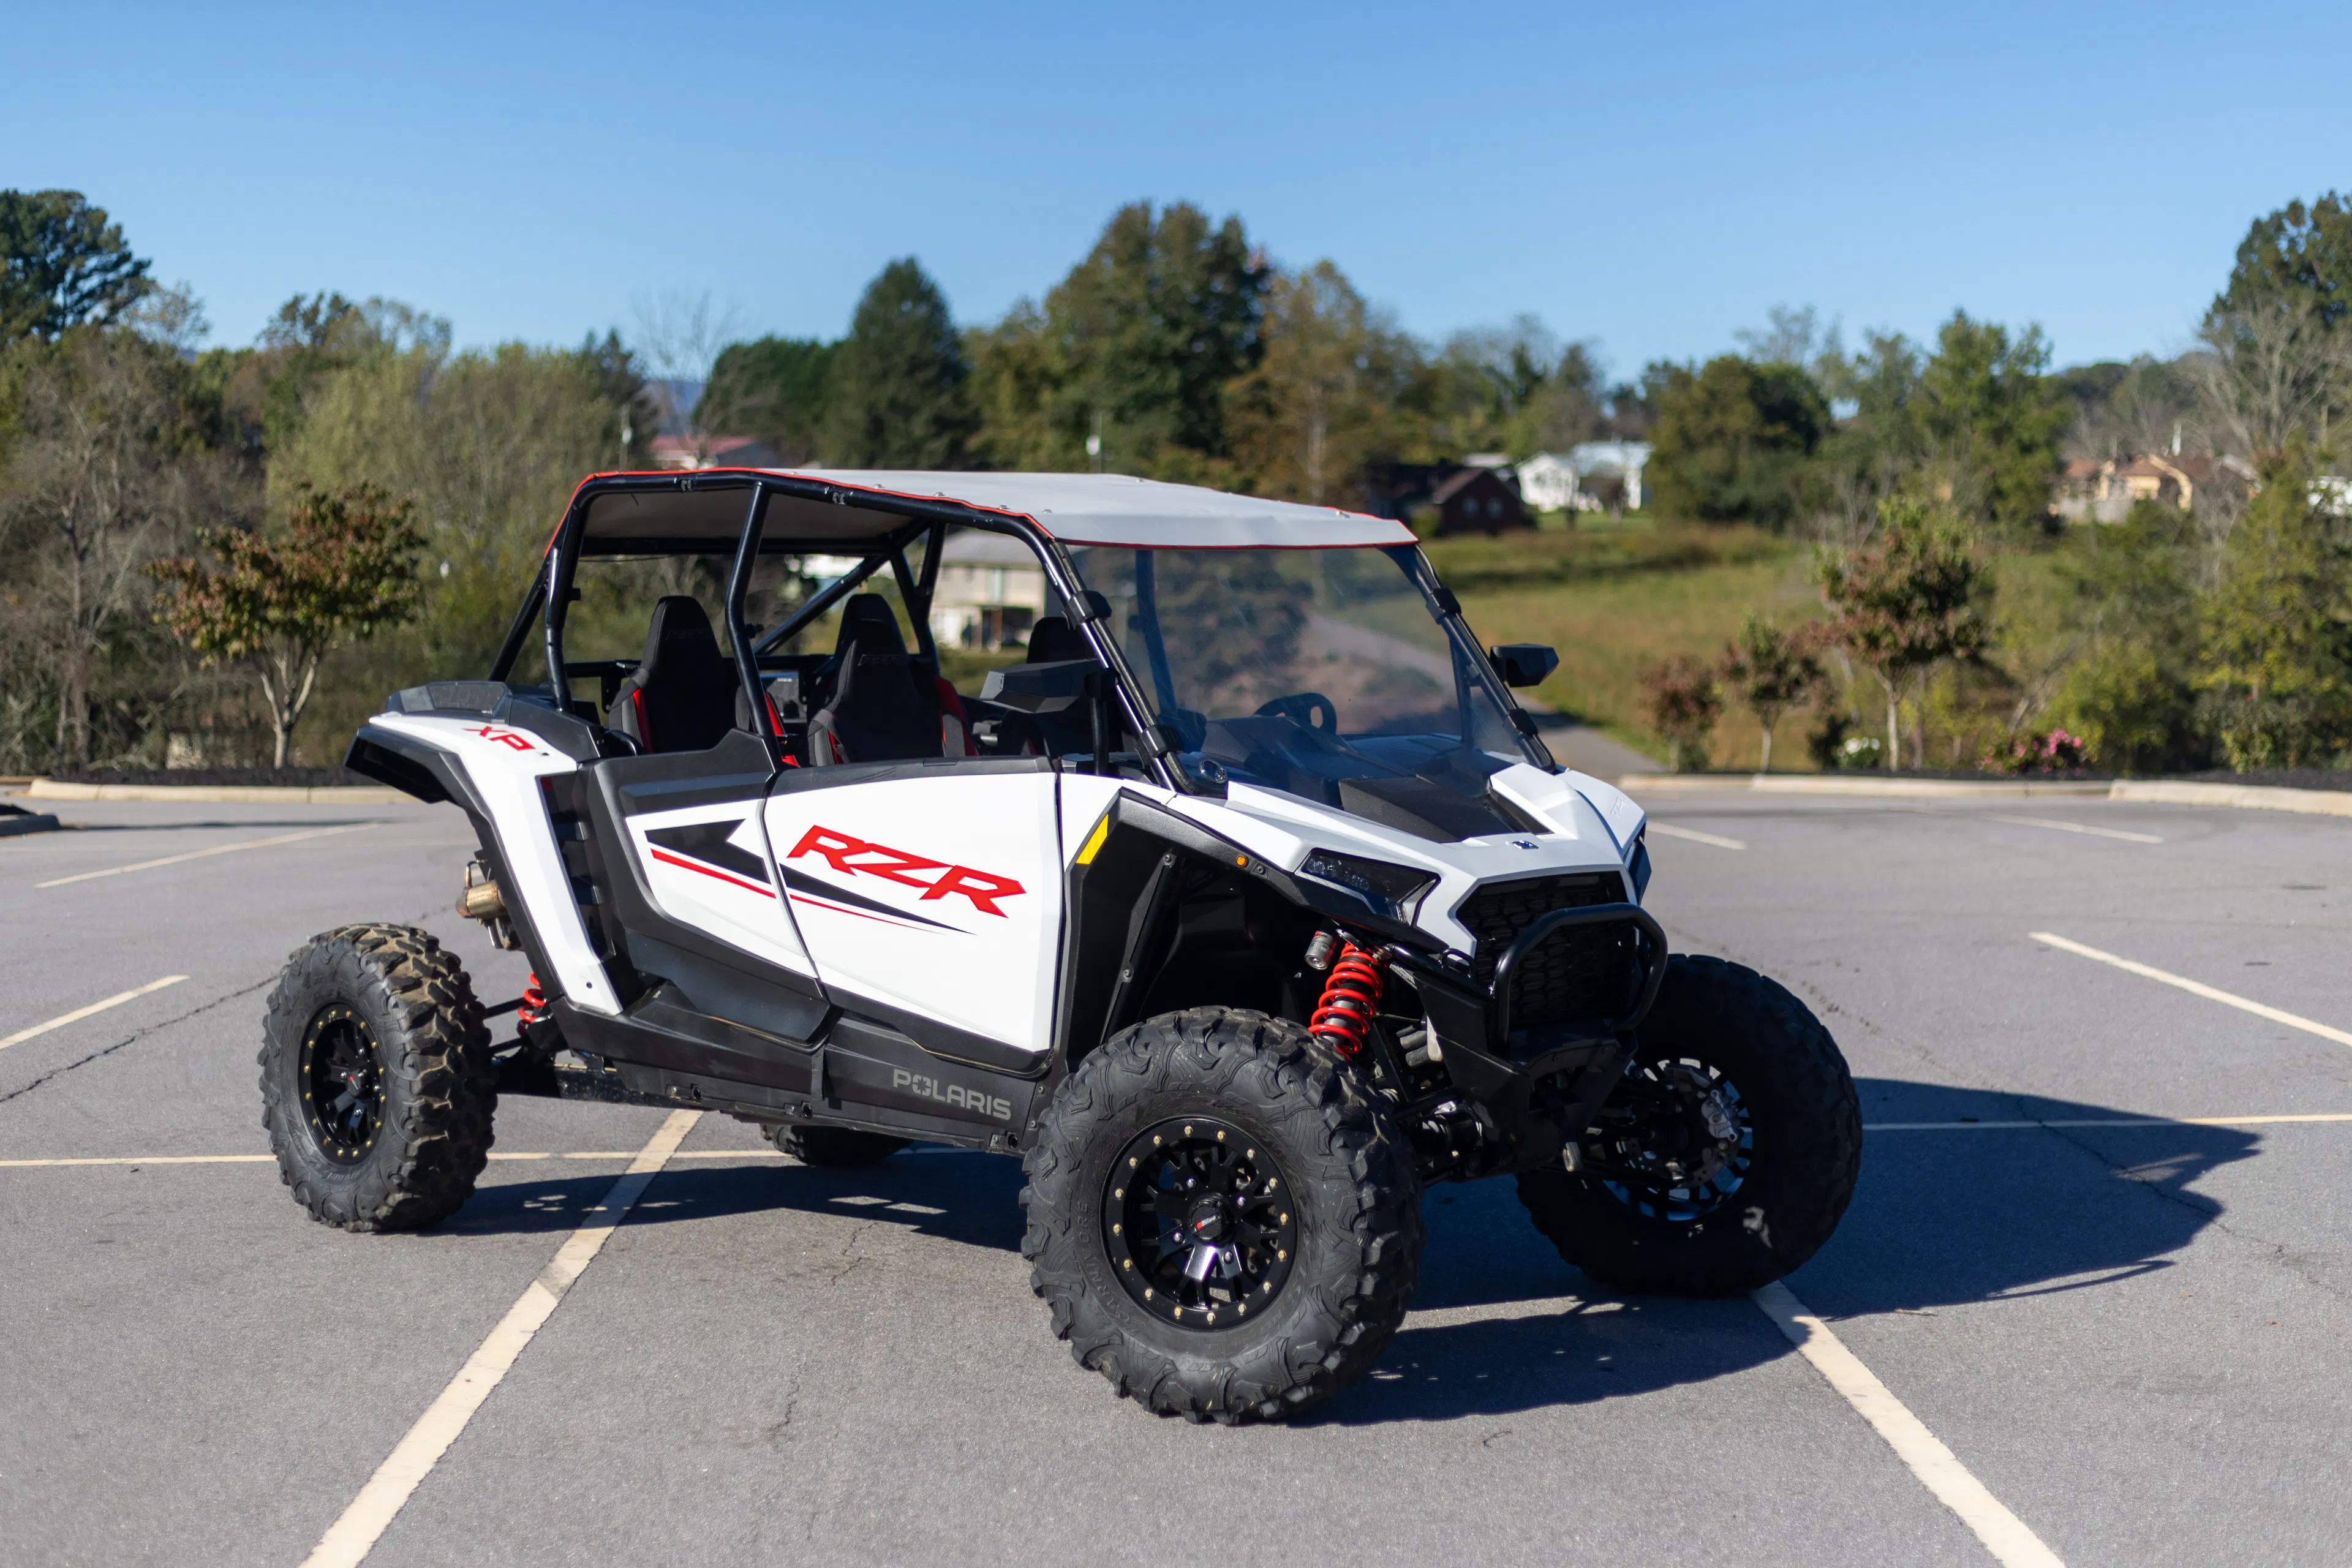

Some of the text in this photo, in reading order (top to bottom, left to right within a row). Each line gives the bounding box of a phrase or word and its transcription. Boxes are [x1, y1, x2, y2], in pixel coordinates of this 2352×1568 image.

[461, 726, 536, 751] XP
[786, 824, 1027, 919] RZR
[892, 1068, 1011, 1121] POLARIS
